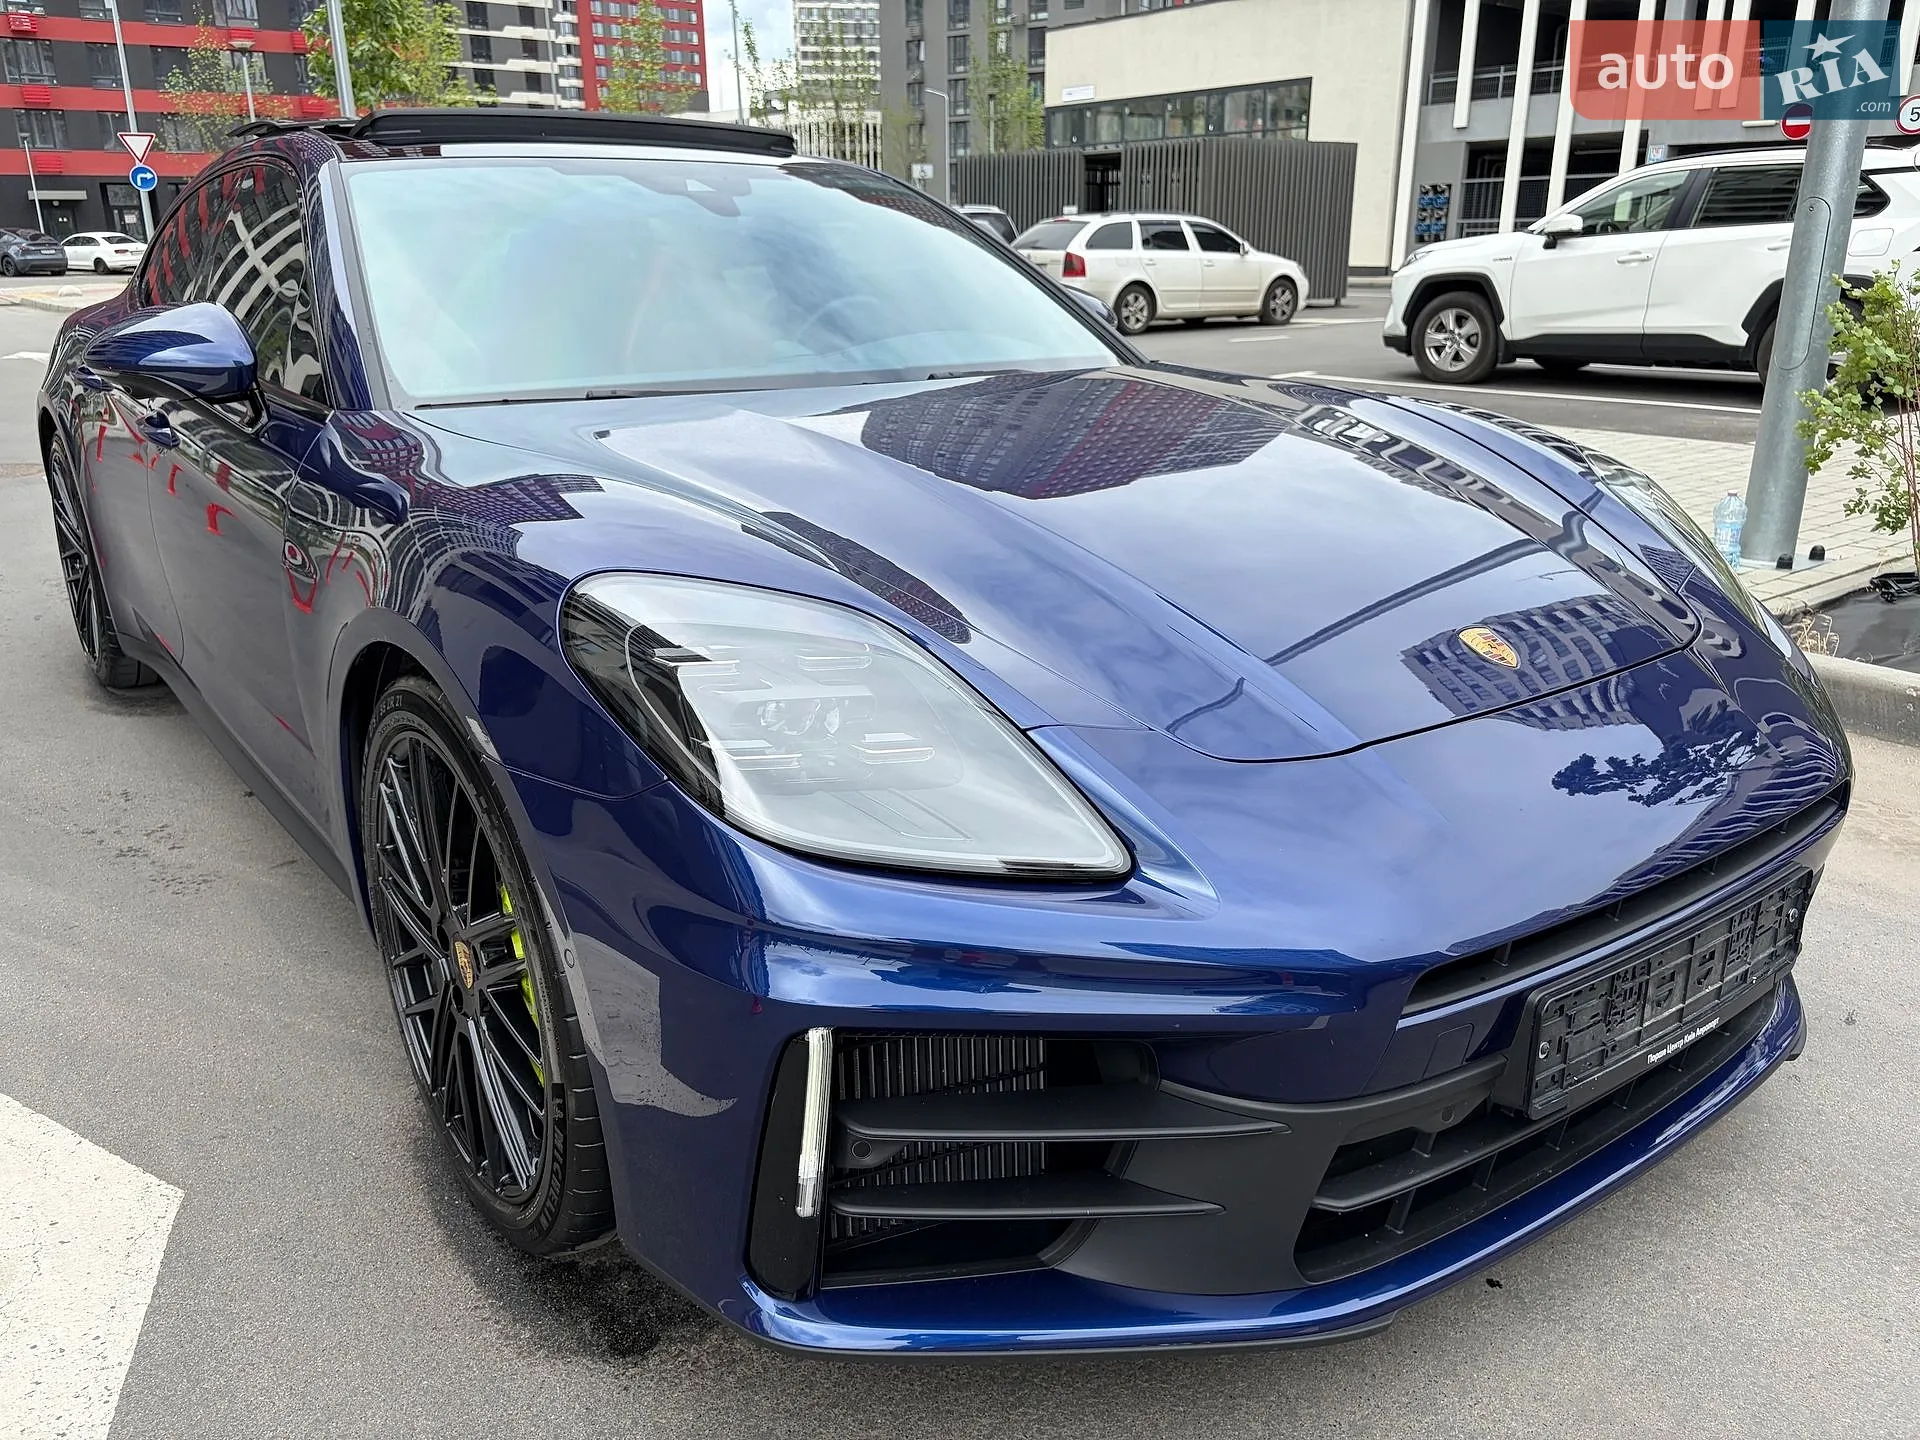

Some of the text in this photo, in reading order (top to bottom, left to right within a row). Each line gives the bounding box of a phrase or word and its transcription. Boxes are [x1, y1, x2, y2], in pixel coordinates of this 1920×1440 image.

[1648, 1049, 1666, 1064] Порше
[1667, 1039, 1683, 1053] Центр
[540, 1125, 564, 1231] MICHELIN
